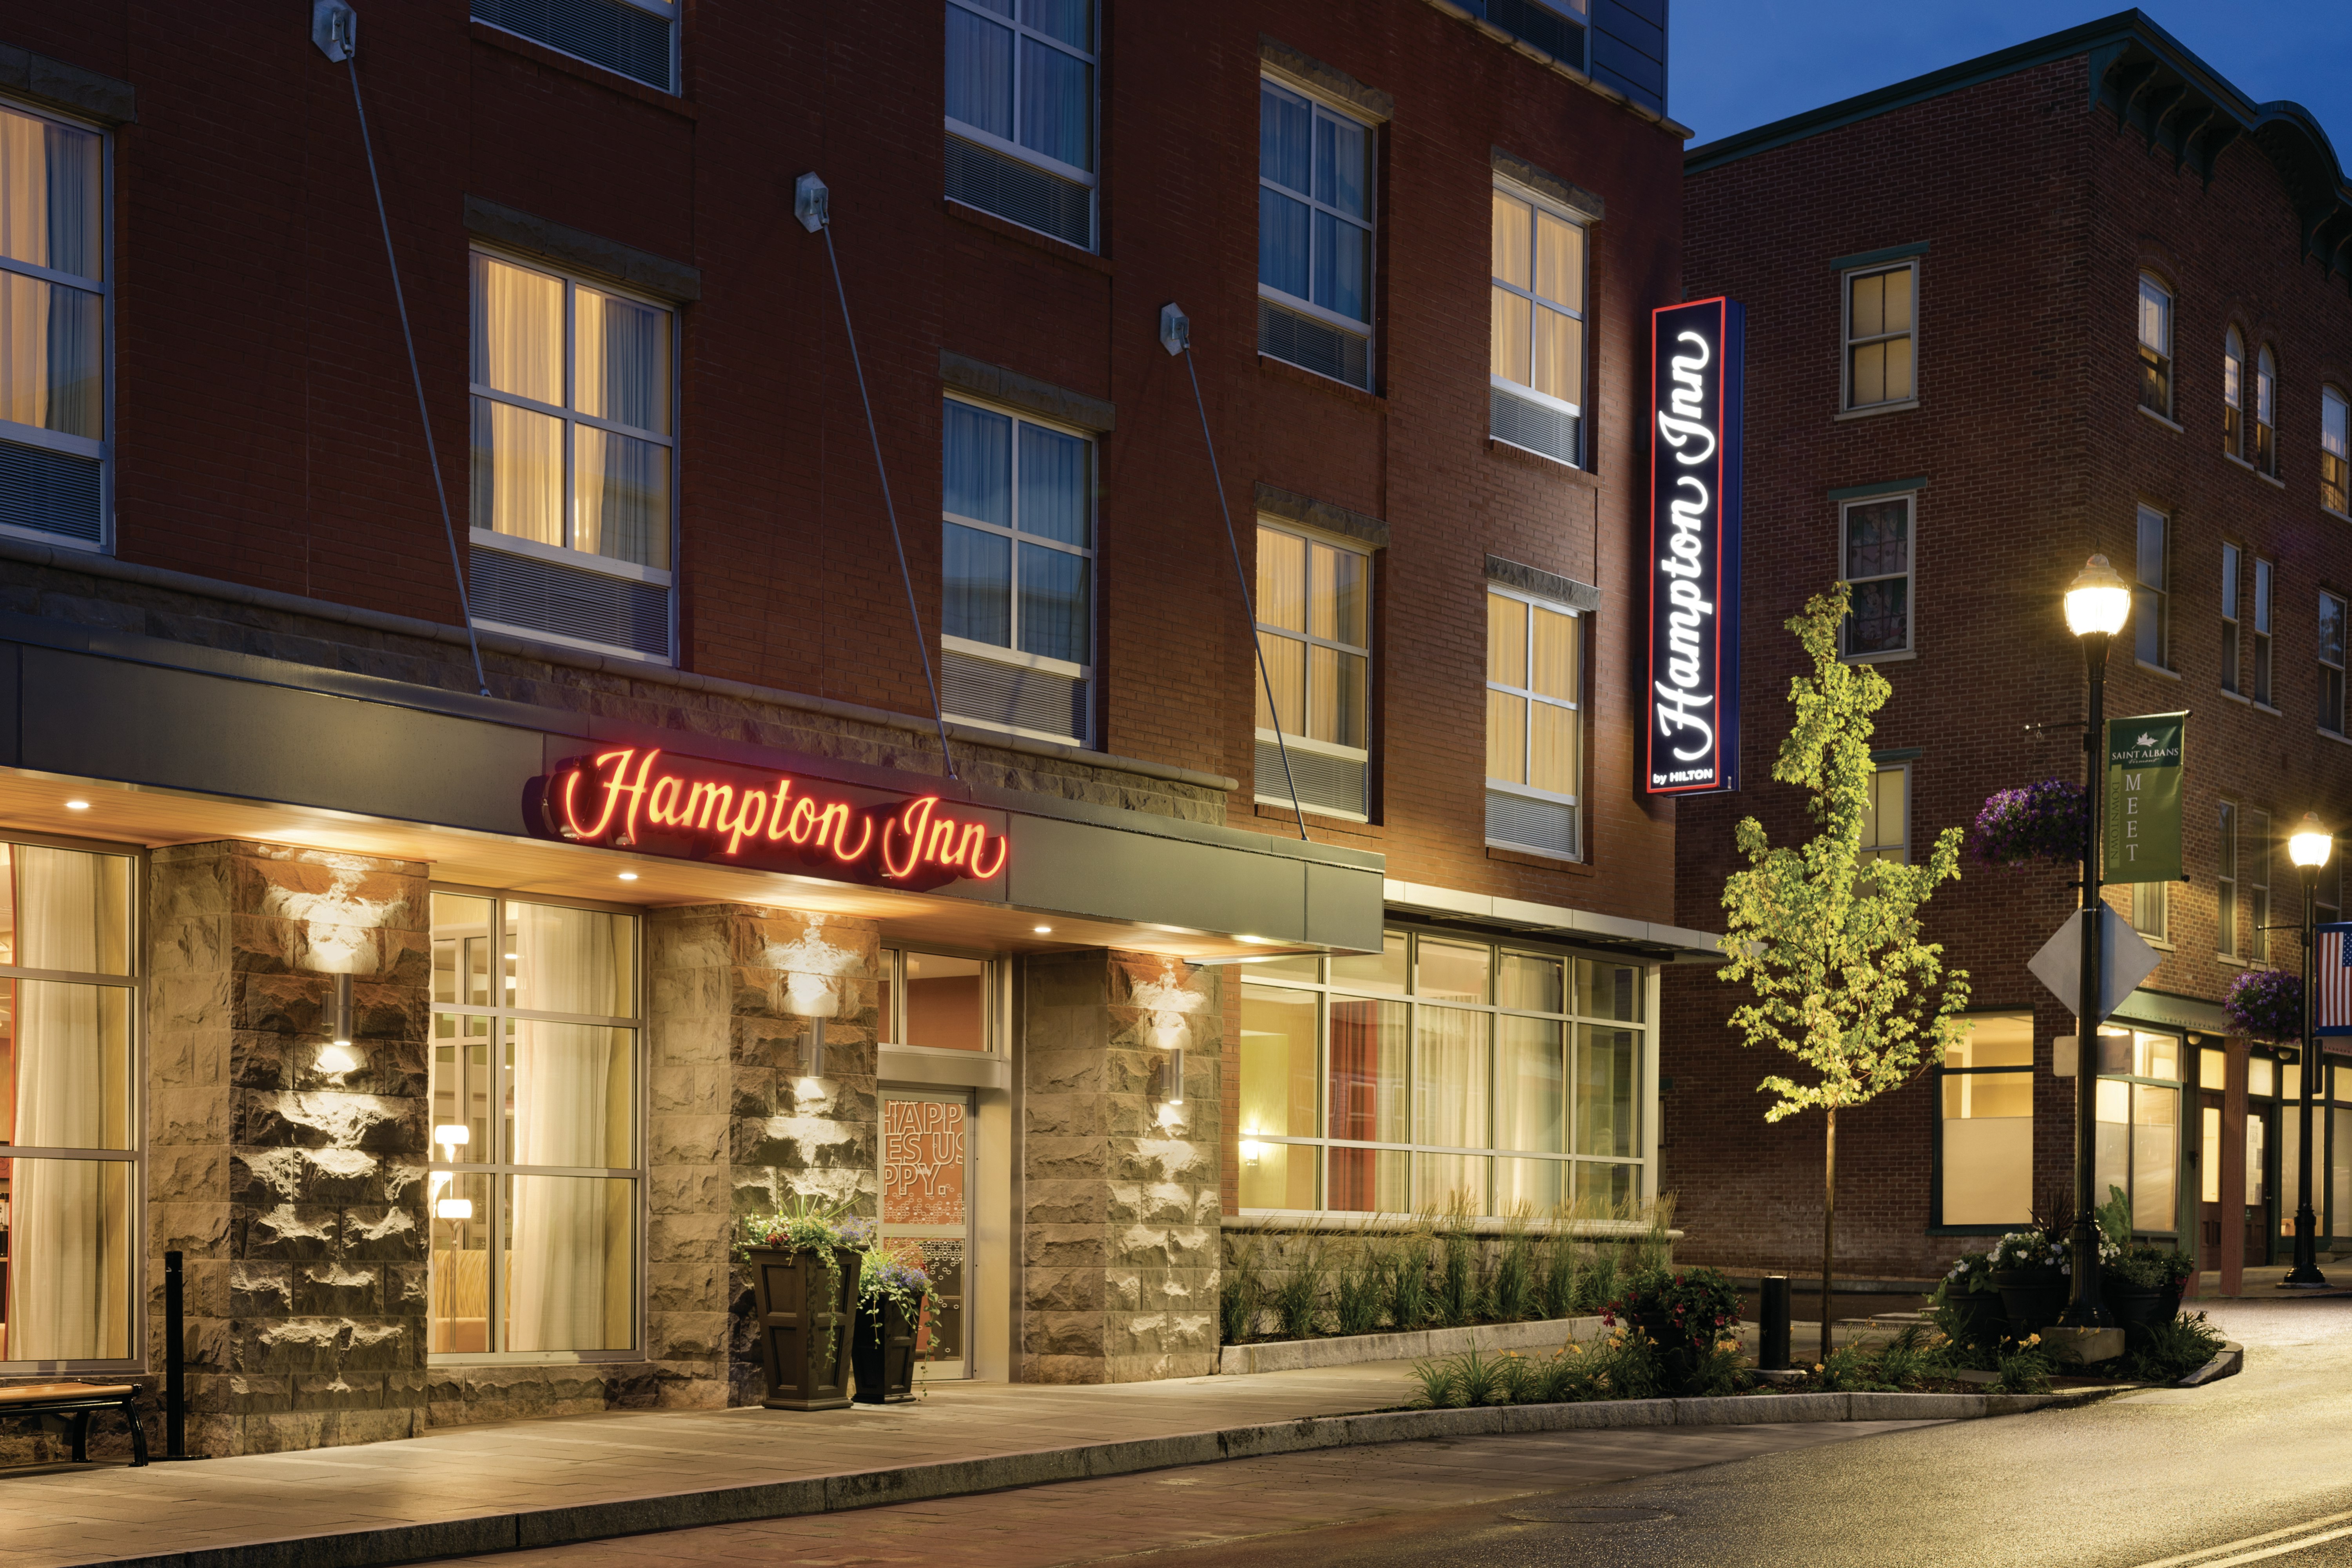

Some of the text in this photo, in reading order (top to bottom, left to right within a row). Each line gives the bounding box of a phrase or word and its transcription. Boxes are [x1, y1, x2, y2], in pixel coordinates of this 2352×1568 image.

[1655, 331, 1715, 761] Hampton Inn
[1653, 768, 1713, 785] by HILTON
[2112, 748, 2179, 760] SAINT ALBANS
[565, 748, 1006, 879] Hampton Inn
[2111, 782, 2120, 860] DOWNTOWN
[2125, 773, 2142, 862] MEET
